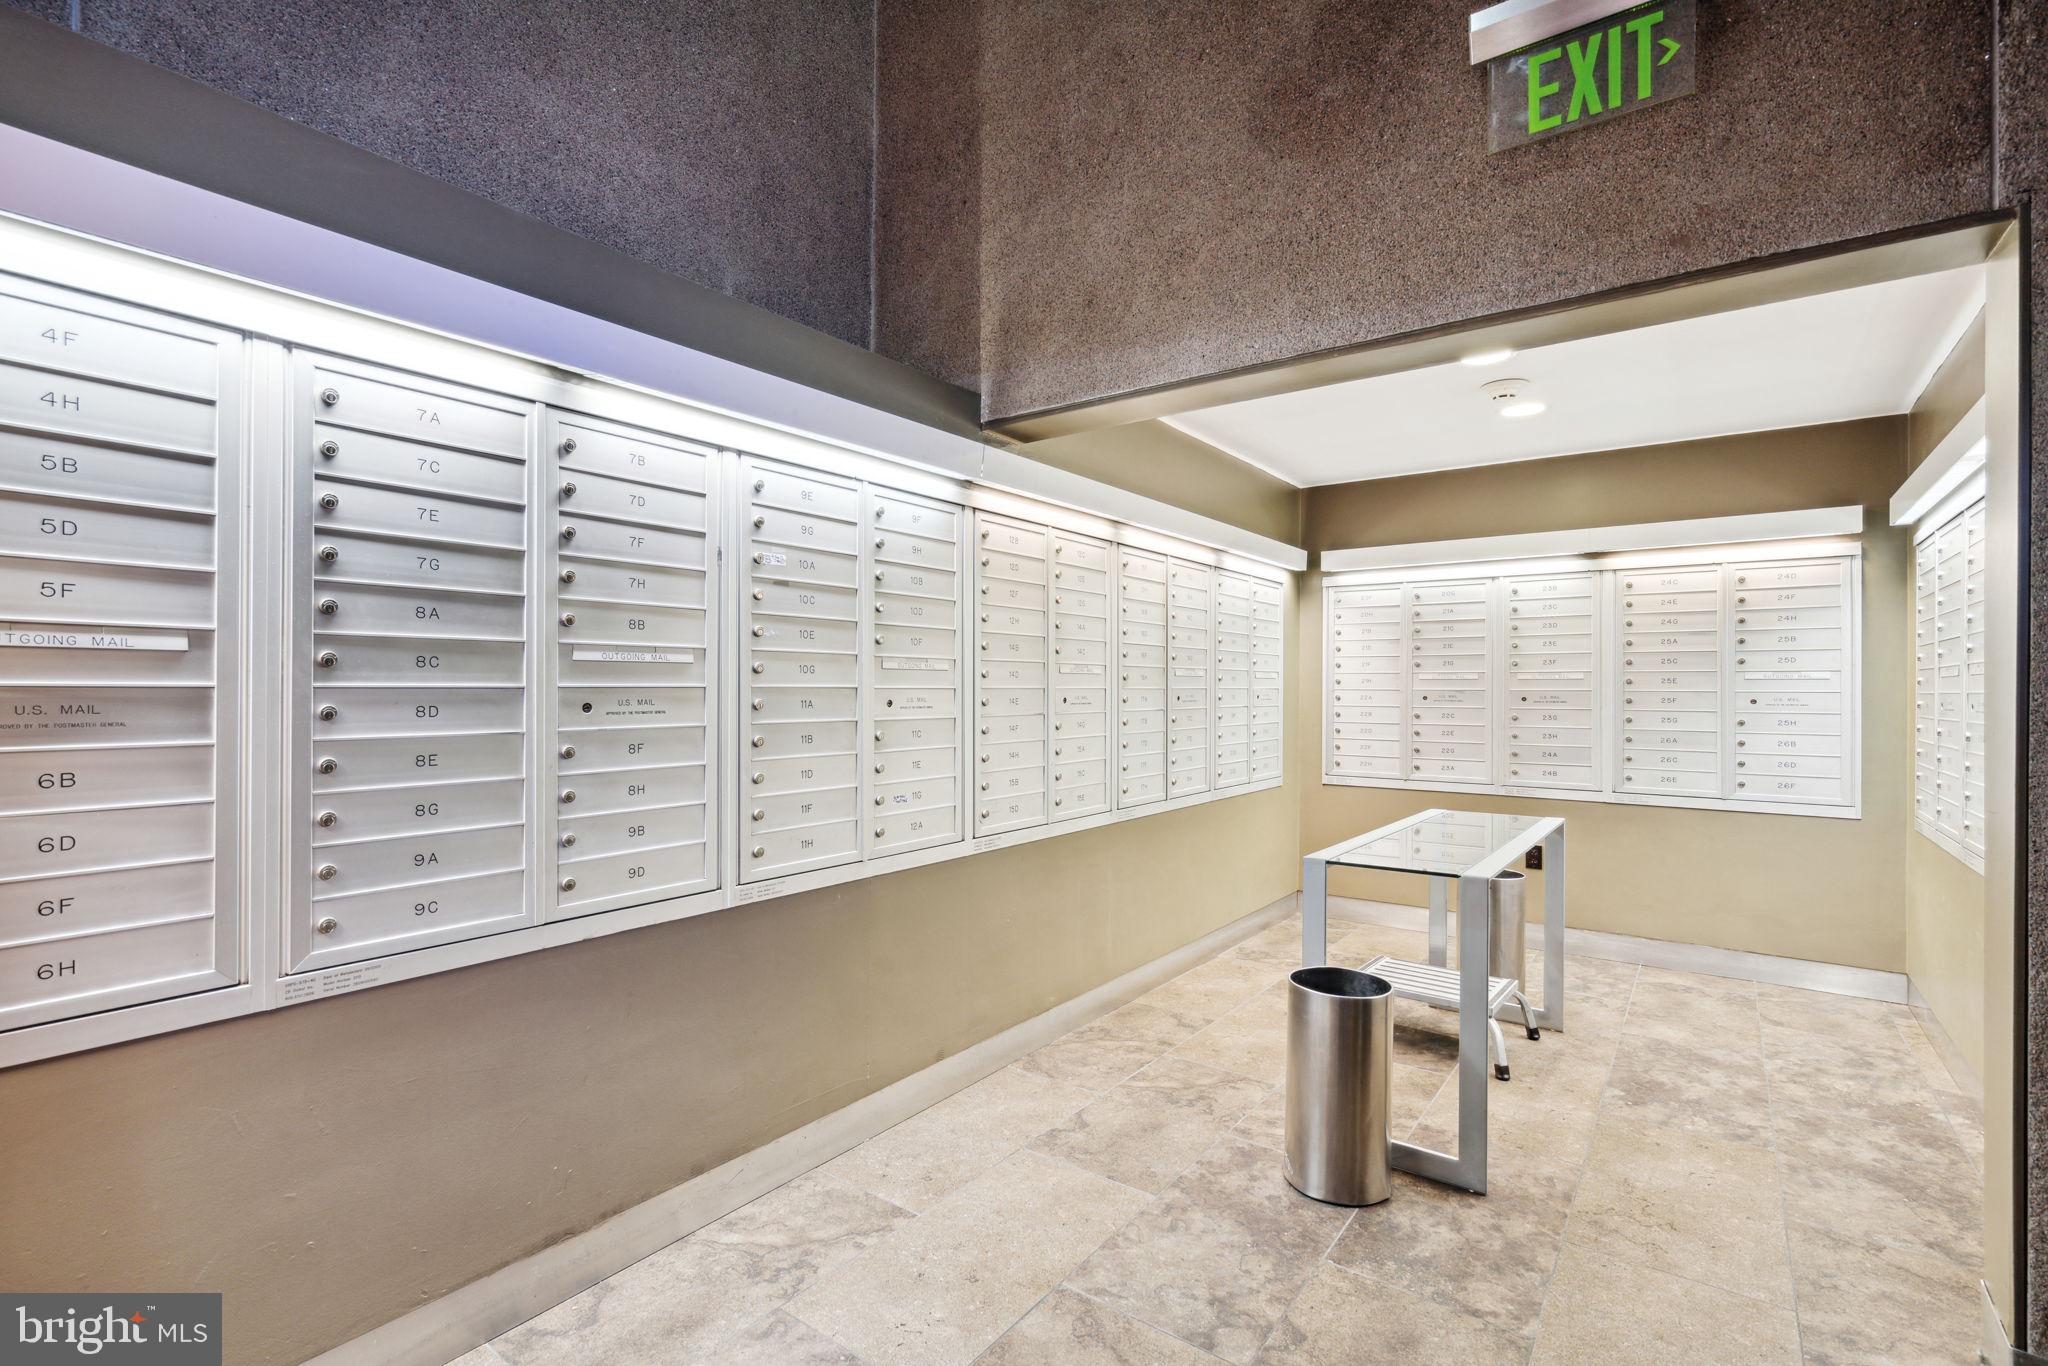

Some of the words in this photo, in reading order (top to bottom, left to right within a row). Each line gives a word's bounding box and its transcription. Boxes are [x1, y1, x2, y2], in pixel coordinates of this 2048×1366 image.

[1528, 9, 1664, 135] EXIT
[41, 328, 75, 345] 4F
[40, 391, 80, 410] 4H
[417, 407, 441, 424] 7A
[40, 454, 78, 474] 5B
[417, 458, 440, 474] 7C
[630, 453, 646, 467] 7B
[630, 494, 646, 507] 7D
[800, 490, 813, 501] 9E
[417, 507, 440, 523] 7E
[40, 518, 78, 536] 5D
[800, 525, 814, 536] 9G
[630, 536, 644, 548] 7F
[417, 556, 440, 571] 7G
[800, 560, 815, 570] 10A
[40, 581, 76, 598] 5F
[630, 577, 646, 589] 7H
[800, 594, 815, 605] 10C
[415, 606, 440, 620] 8A
[628, 618, 646, 631] 8B
[0, 632, 77, 646] TGOING
[92, 636, 135, 648] MAIL
[800, 629, 814, 640] 10E
[415, 655, 440, 669] 8C
[602, 652, 646, 660] OUTGOING
[800, 664, 815, 675] 10G
[14, 704, 48, 716] U.S.
[60, 704, 101, 715] MAIL
[800, 699, 814, 709] 11A
[415, 705, 439, 718] 8D
[801, 734, 814, 744] 11B
[628, 742, 644, 755] 8F
[415, 753, 438, 768] 8E
[800, 769, 814, 779] 11D
[37, 772, 76, 790] 6B
[627, 784, 645, 796] 8H
[414, 802, 439, 817] 8G
[801, 803, 813, 814] 11F
[628, 825, 645, 838] 9B
[37, 835, 76, 853] 6D
[801, 838, 814, 849] 11H
[414, 852, 439, 867] 9A
[628, 866, 645, 879] 9D
[37, 897, 73, 917] 6F
[414, 900, 439, 916] 9C
[36, 960, 76, 981] 6H
